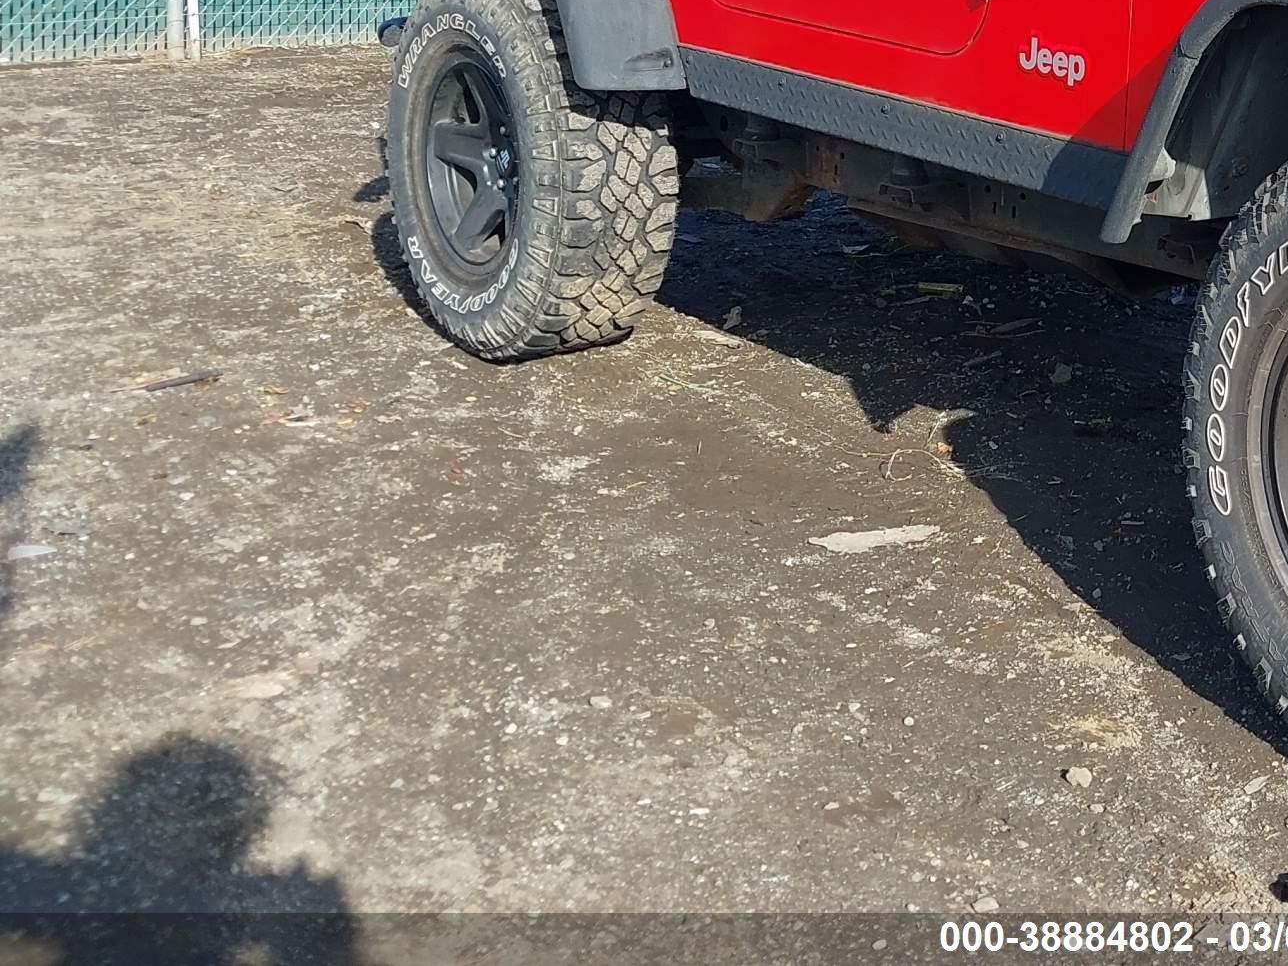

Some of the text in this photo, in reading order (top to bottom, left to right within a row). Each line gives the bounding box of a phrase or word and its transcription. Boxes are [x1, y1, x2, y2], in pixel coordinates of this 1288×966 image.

[398, 13, 506, 88] WRANGLER
[1019, 36, 1086, 87] Jeep
[407, 236, 519, 314] GOODYEAR
